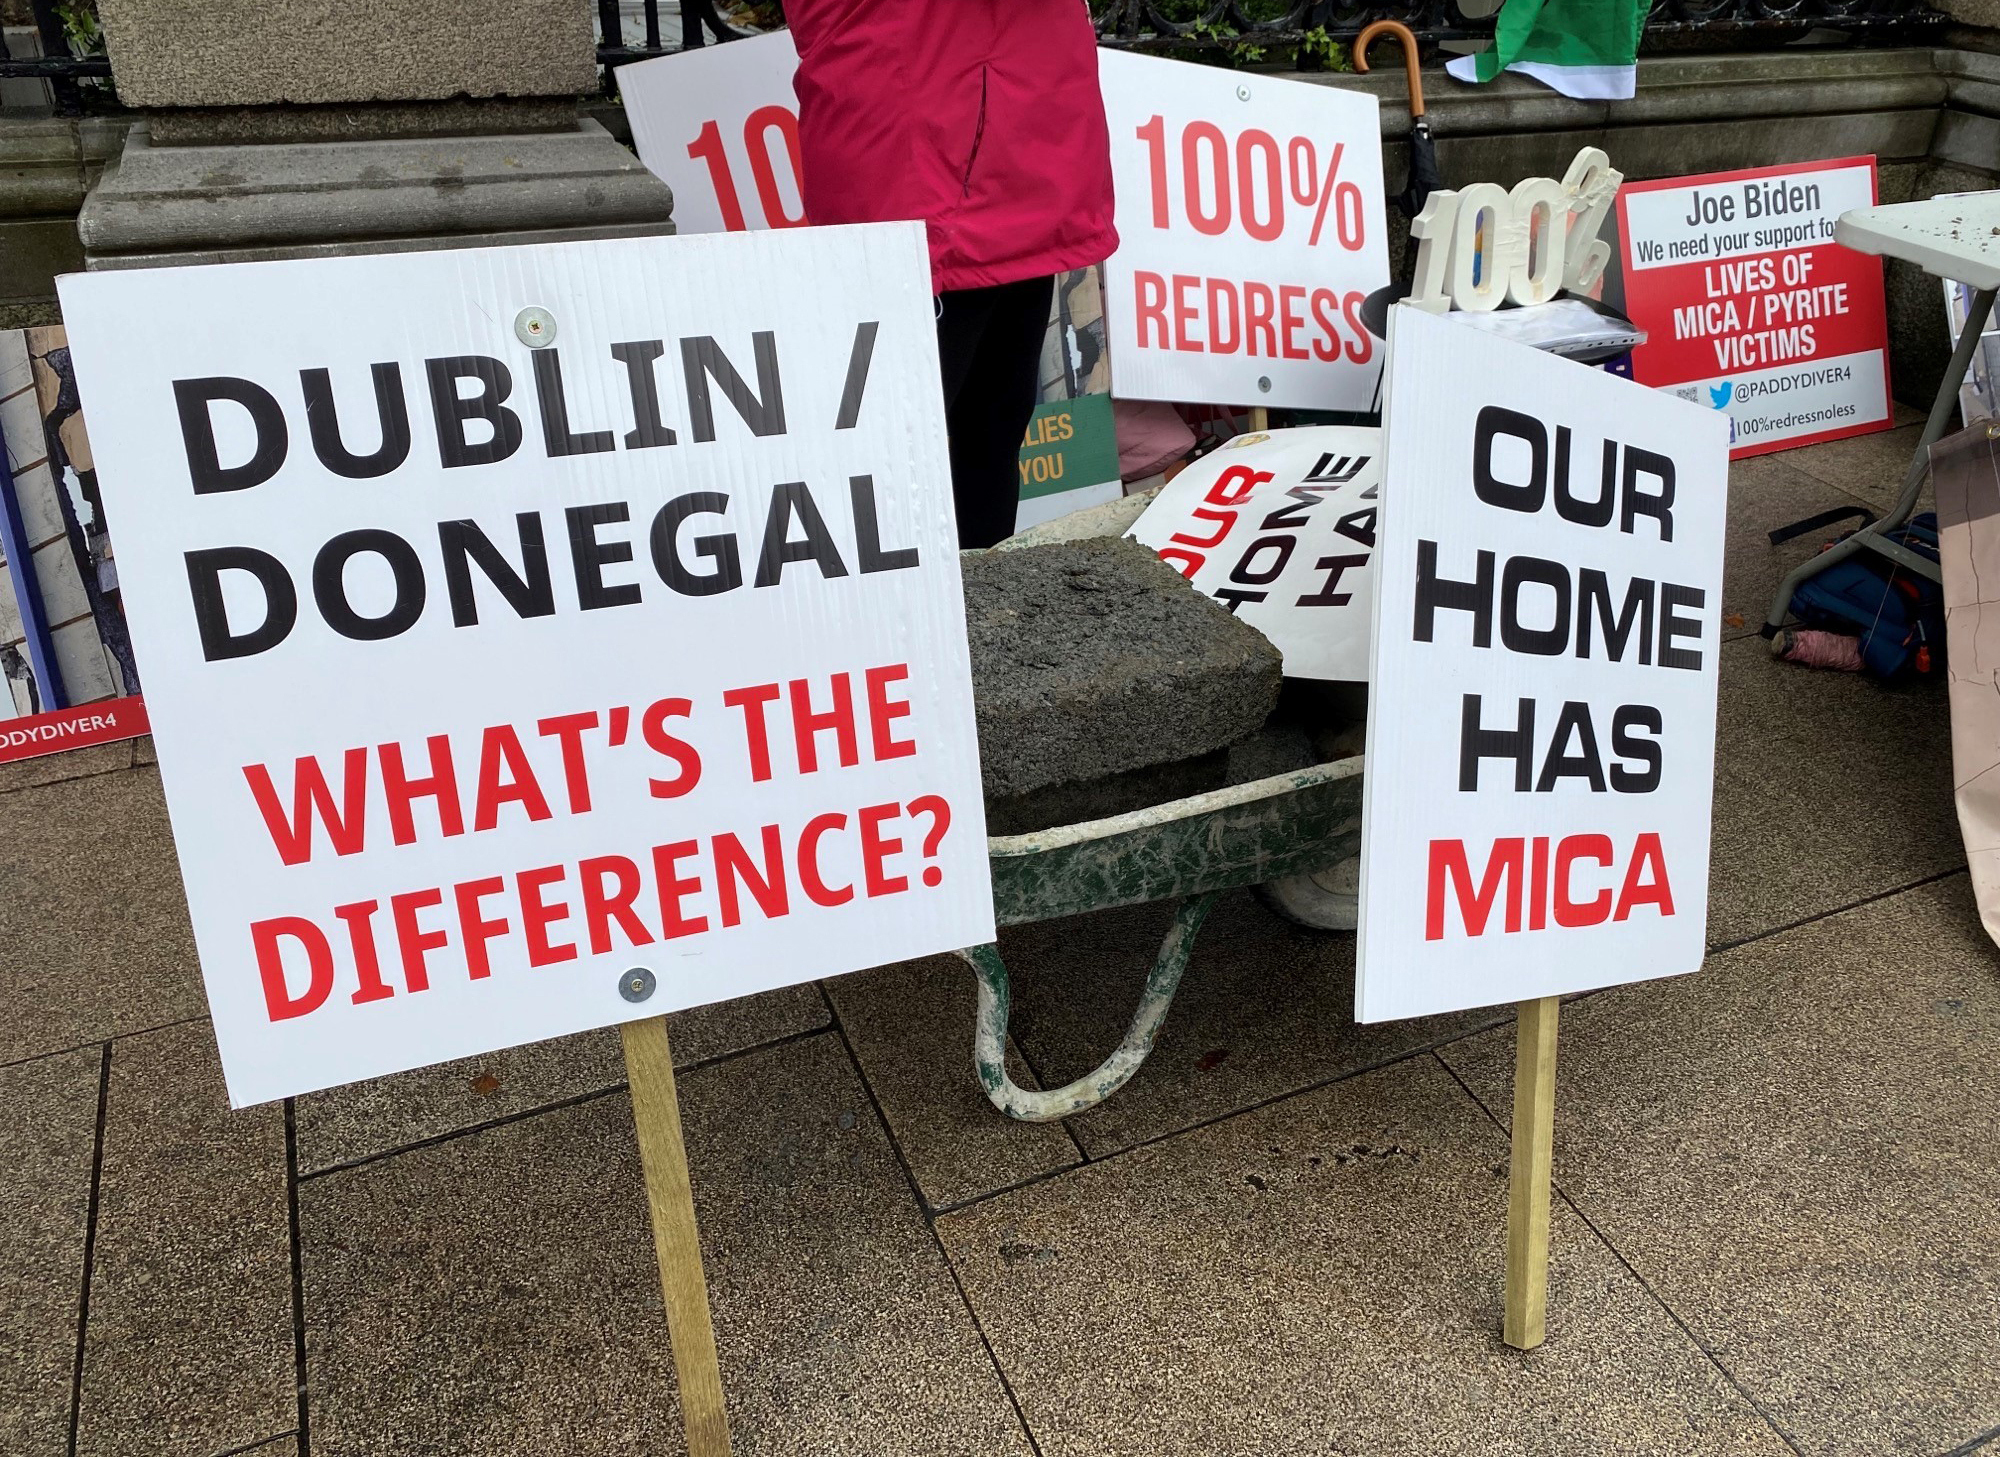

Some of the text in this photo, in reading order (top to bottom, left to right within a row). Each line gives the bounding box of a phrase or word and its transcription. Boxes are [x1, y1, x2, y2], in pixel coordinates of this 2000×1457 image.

[1136, 115, 1364, 251] 100%
[1399, 146, 1624, 313] 100%
[1686, 180, 1820, 227] Joe Biden
[1637, 240, 1664, 263] We
[1669, 233, 1709, 259] need
[1713, 231, 1750, 257] your
[1754, 219, 1815, 249] support
[1704, 252, 1813, 299] LIVES OF
[1136, 272, 1371, 365] REDRESS
[1673, 283, 1850, 341] MICA / PYRITE
[1713, 324, 1817, 370] VICTIMS
[172, 321, 880, 496] DUBLIN /
[1735, 365, 1852, 403] @PADDYDIVER4
[1736, 404, 1856, 437] 100%redressnoless
[1019, 453, 1064, 485] YOU
[1474, 405, 1676, 543] OUR
[184, 475, 920, 662] DONEGAL
[1413, 539, 1706, 672] HOME
[242, 663, 917, 866] WHAT'S THE
[1458, 694, 1663, 794] HAS
[250, 794, 951, 1022] DIFFERENCE?
[1425, 832, 1675, 941] MICA
